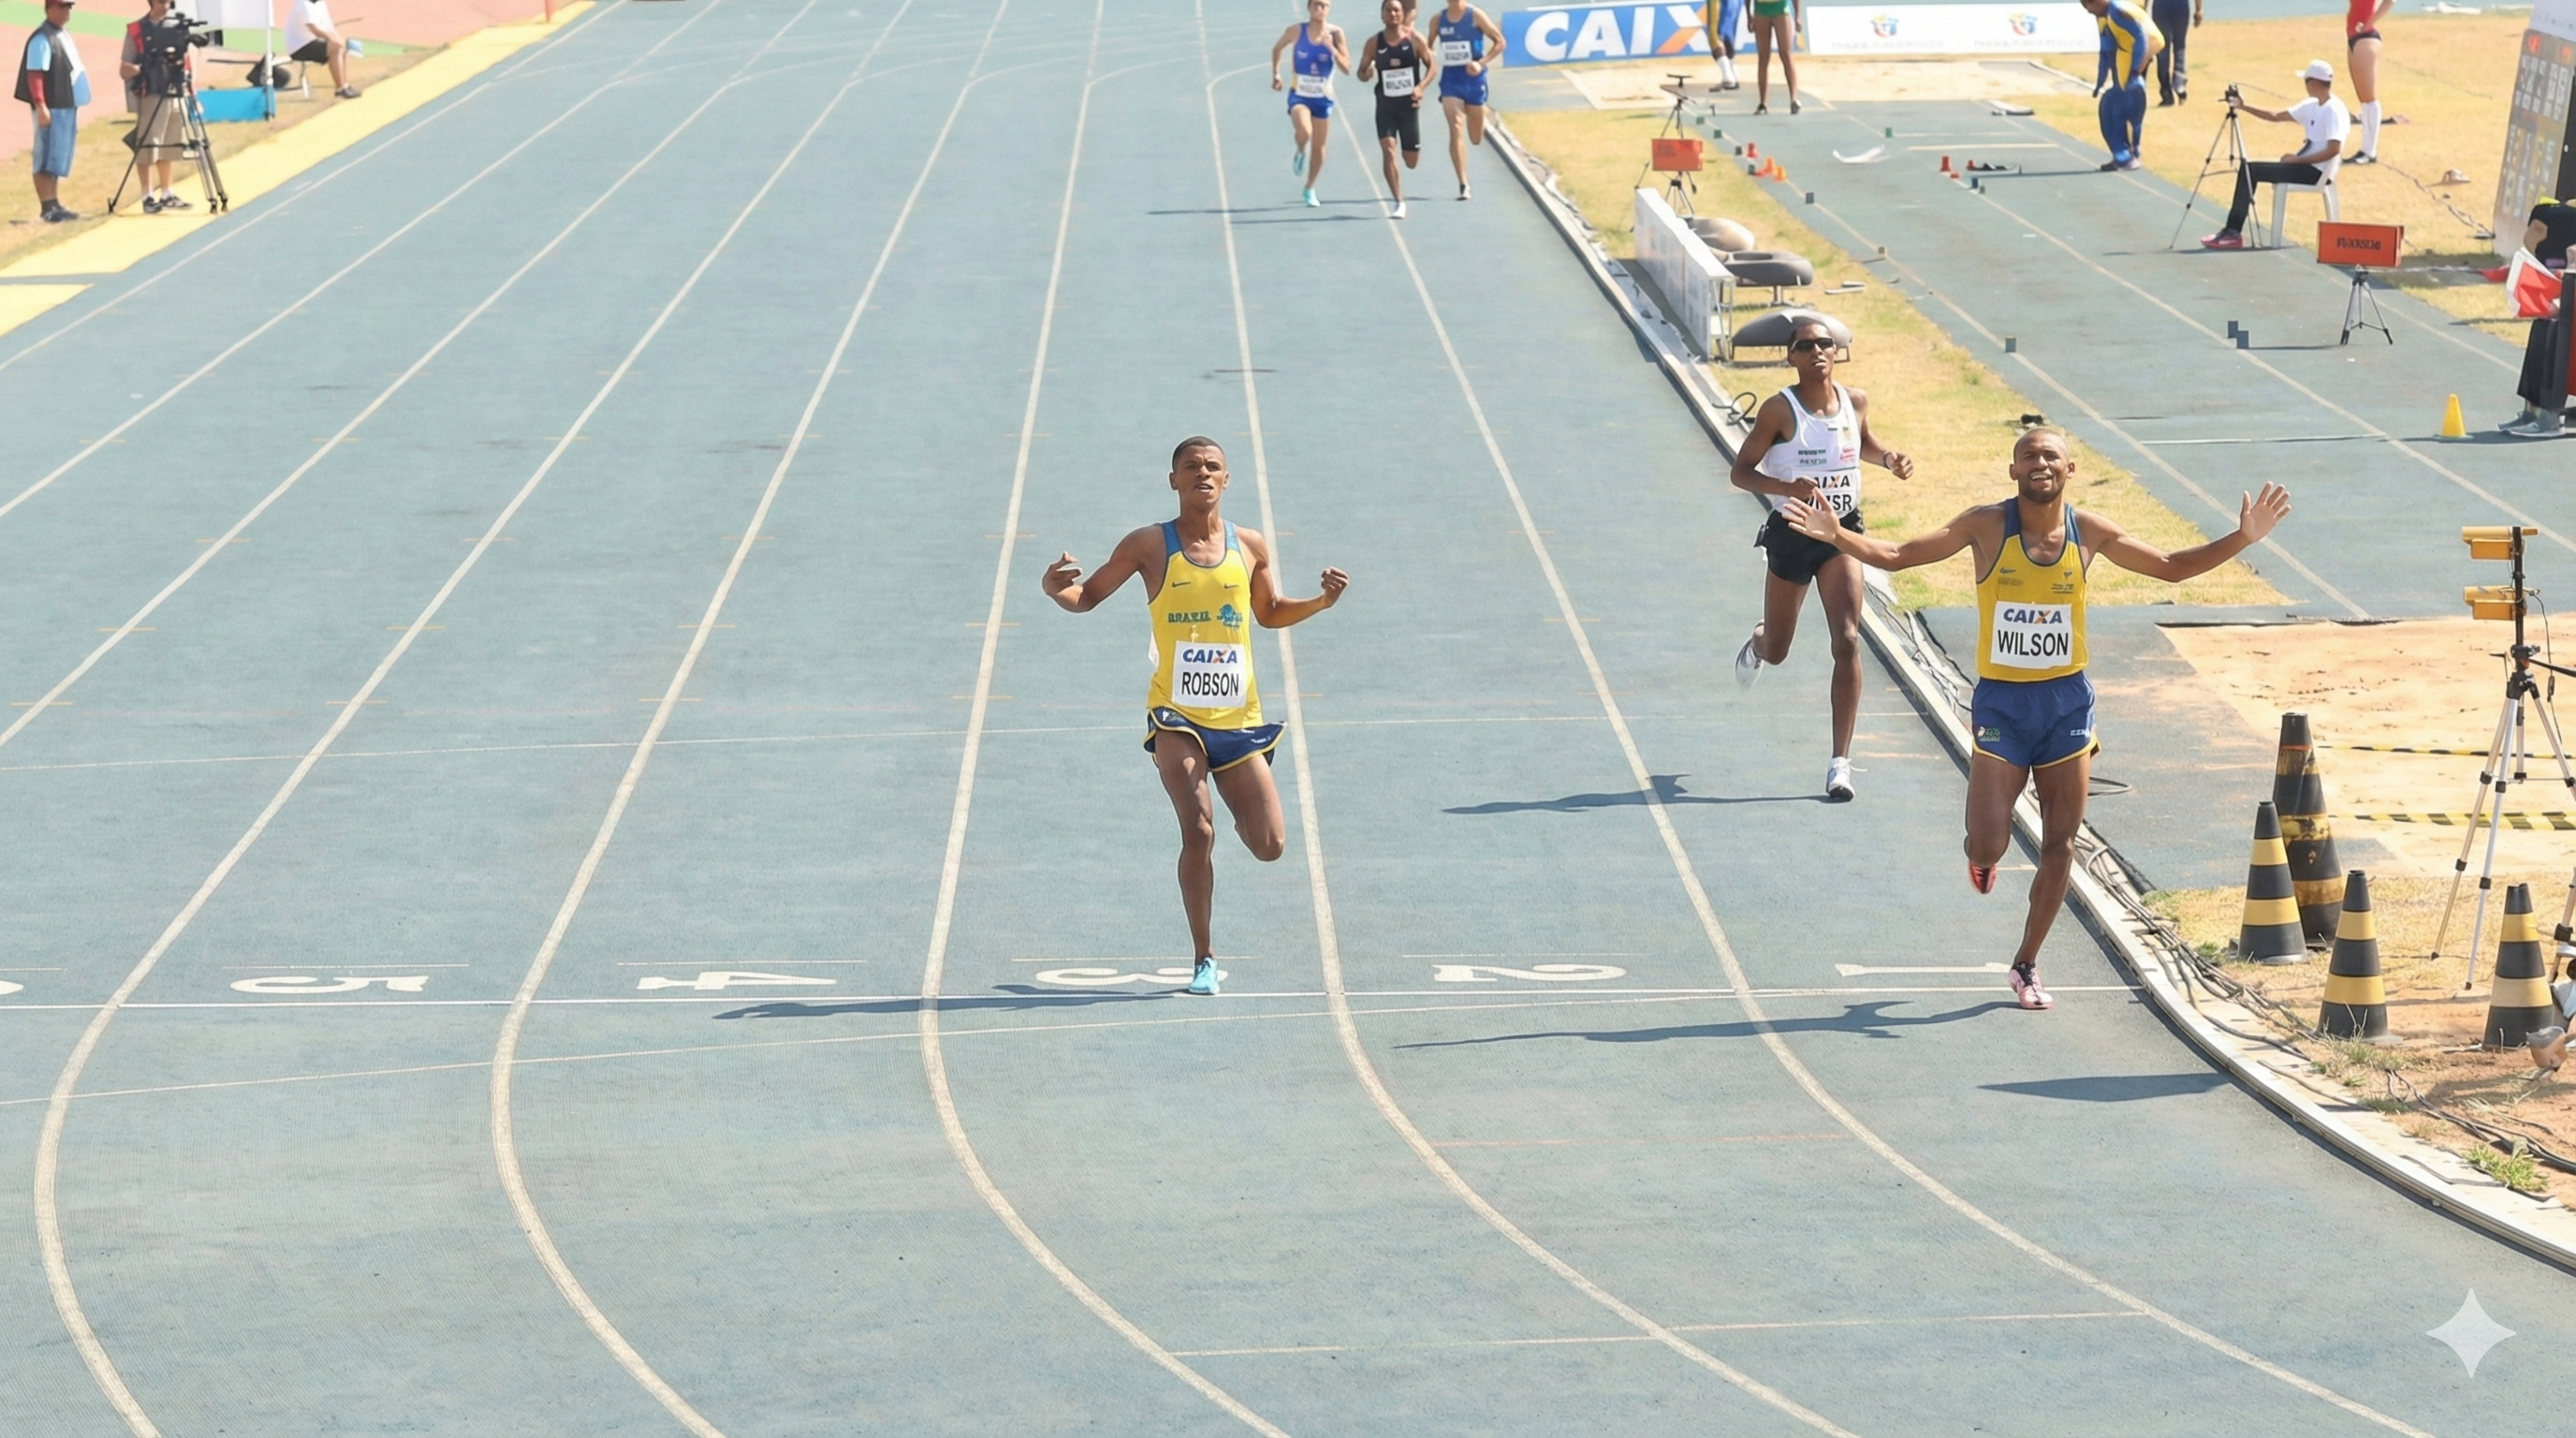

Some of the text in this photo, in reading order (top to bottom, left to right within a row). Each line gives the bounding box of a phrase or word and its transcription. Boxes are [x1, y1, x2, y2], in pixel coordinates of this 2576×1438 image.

[1813, 475, 1851, 489] IXA
[2003, 609, 2062, 624] CAIXA
[1998, 629, 2069, 657] WILSON
[1182, 649, 1237, 664] CAIXA
[1181, 671, 1239, 697] ROBSON
[1035, 967, 1229, 985] 3
[1432, 963, 1627, 982] 2
[1835, 961, 2012, 976] 1
[230, 976, 430, 993] 5
[637, 971, 837, 990] 4
